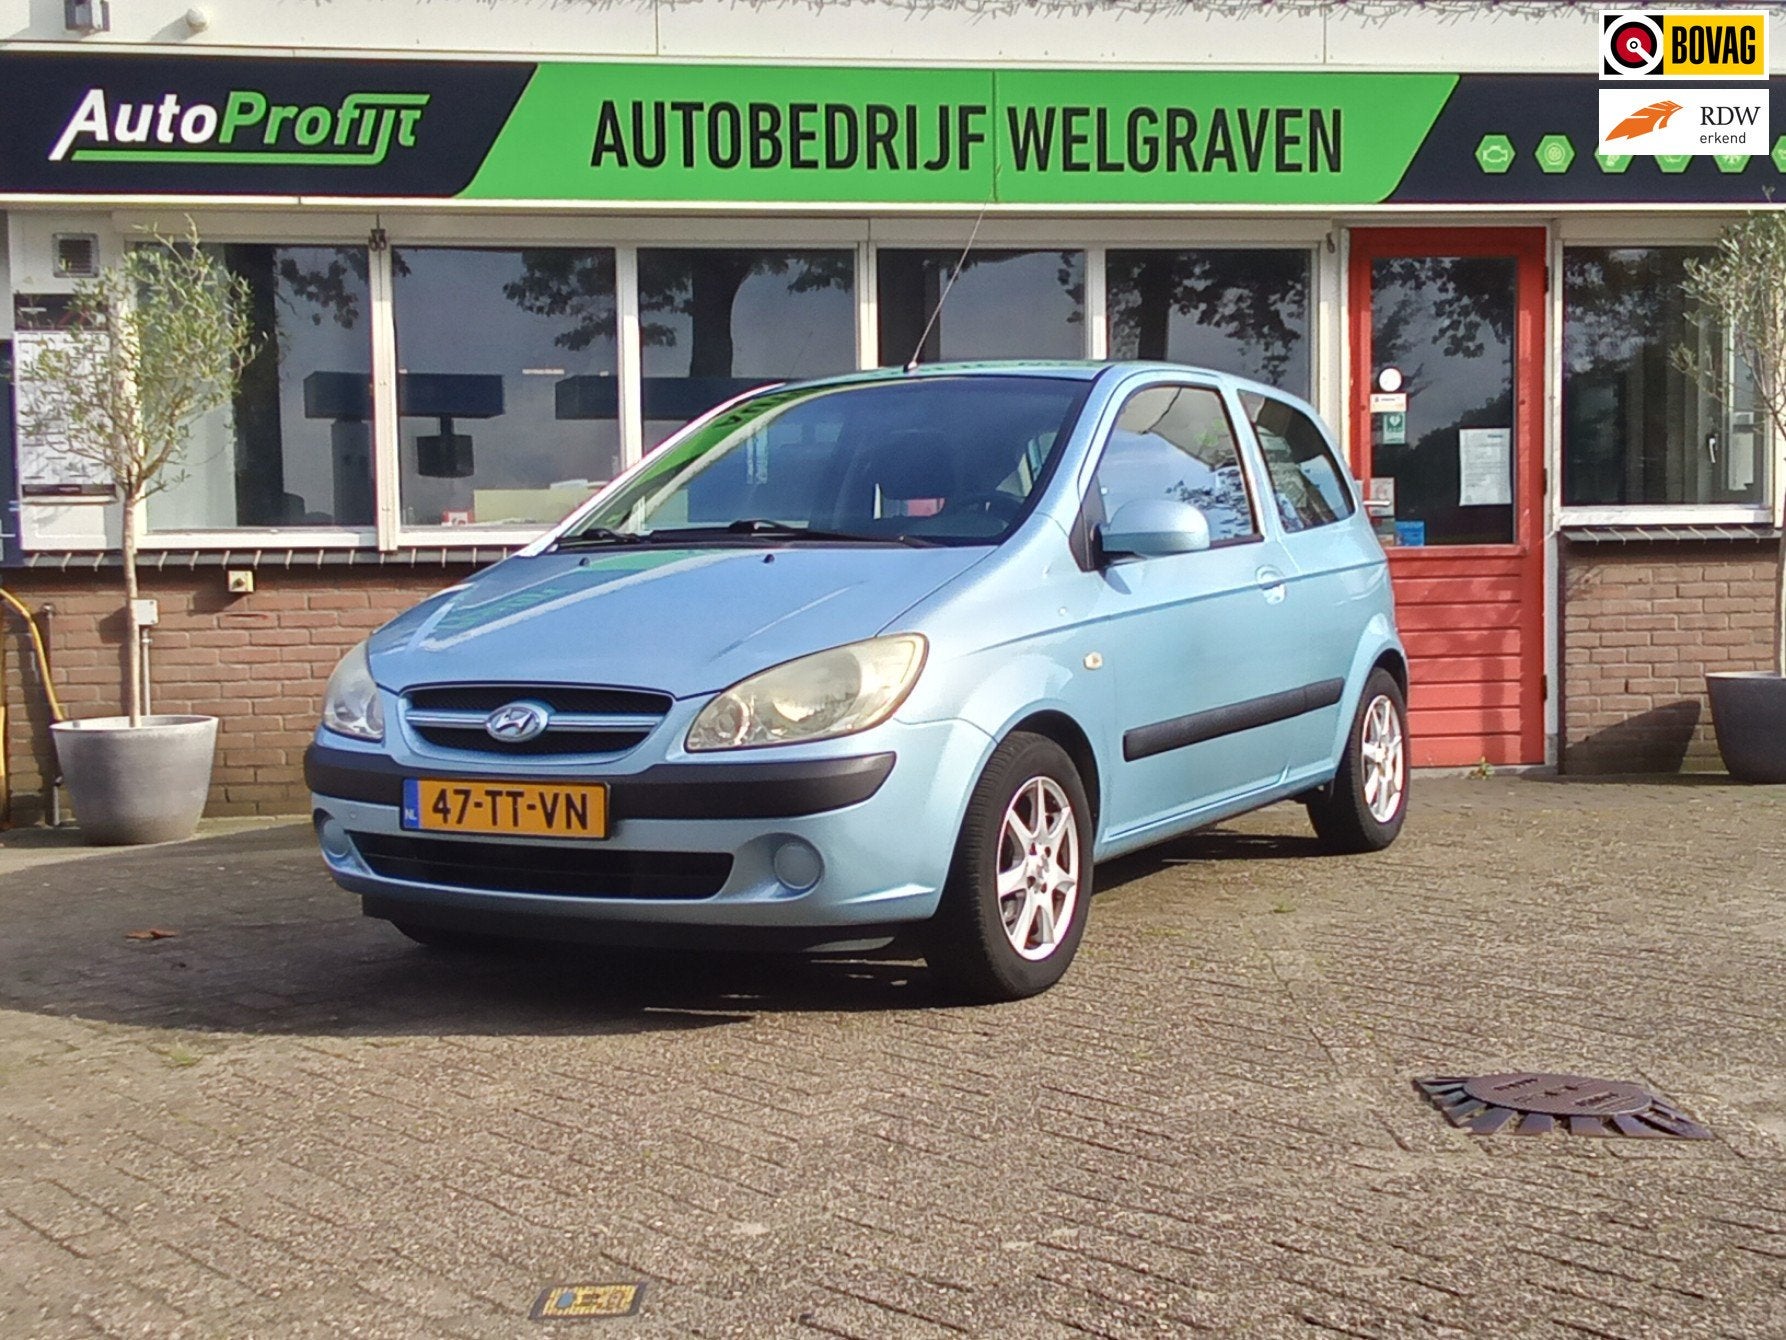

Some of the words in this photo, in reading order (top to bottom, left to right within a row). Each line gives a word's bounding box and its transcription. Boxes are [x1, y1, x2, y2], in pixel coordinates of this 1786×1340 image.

[49, 88, 431, 165] AutoProfijt
[590, 99, 988, 172] AUTOBEDRIJF
[1007, 105, 1343, 174] WELGRAVEN
[404, 807, 417, 820] NL
[432, 788, 588, 830] 47-TT-VN
